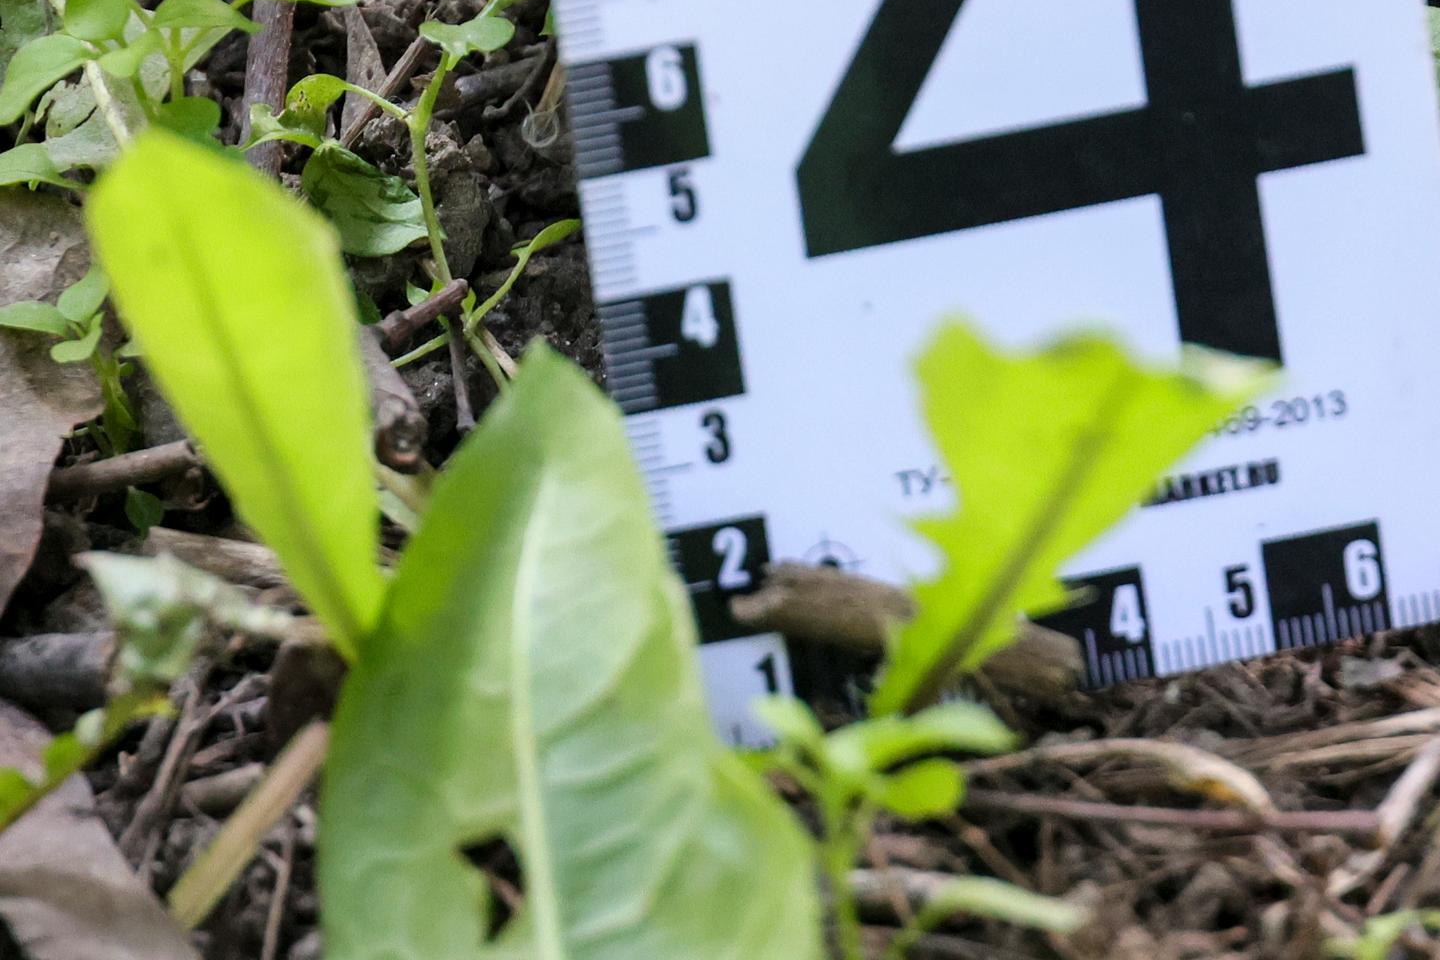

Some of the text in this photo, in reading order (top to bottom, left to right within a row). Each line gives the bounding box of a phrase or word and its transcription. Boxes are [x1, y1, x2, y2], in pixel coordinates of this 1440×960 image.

[645, 44, 688, 112] 6
[667, 166, 697, 223] 5
[681, 284, 719, 347] 4
[700, 410, 732, 465] 3
[711, 527, 752, 590] 2
[1110, 582, 1147, 645] 4
[1224, 564, 1254, 619] 5
[1343, 539, 1383, 602] 6
[754, 651, 778, 695] 1
